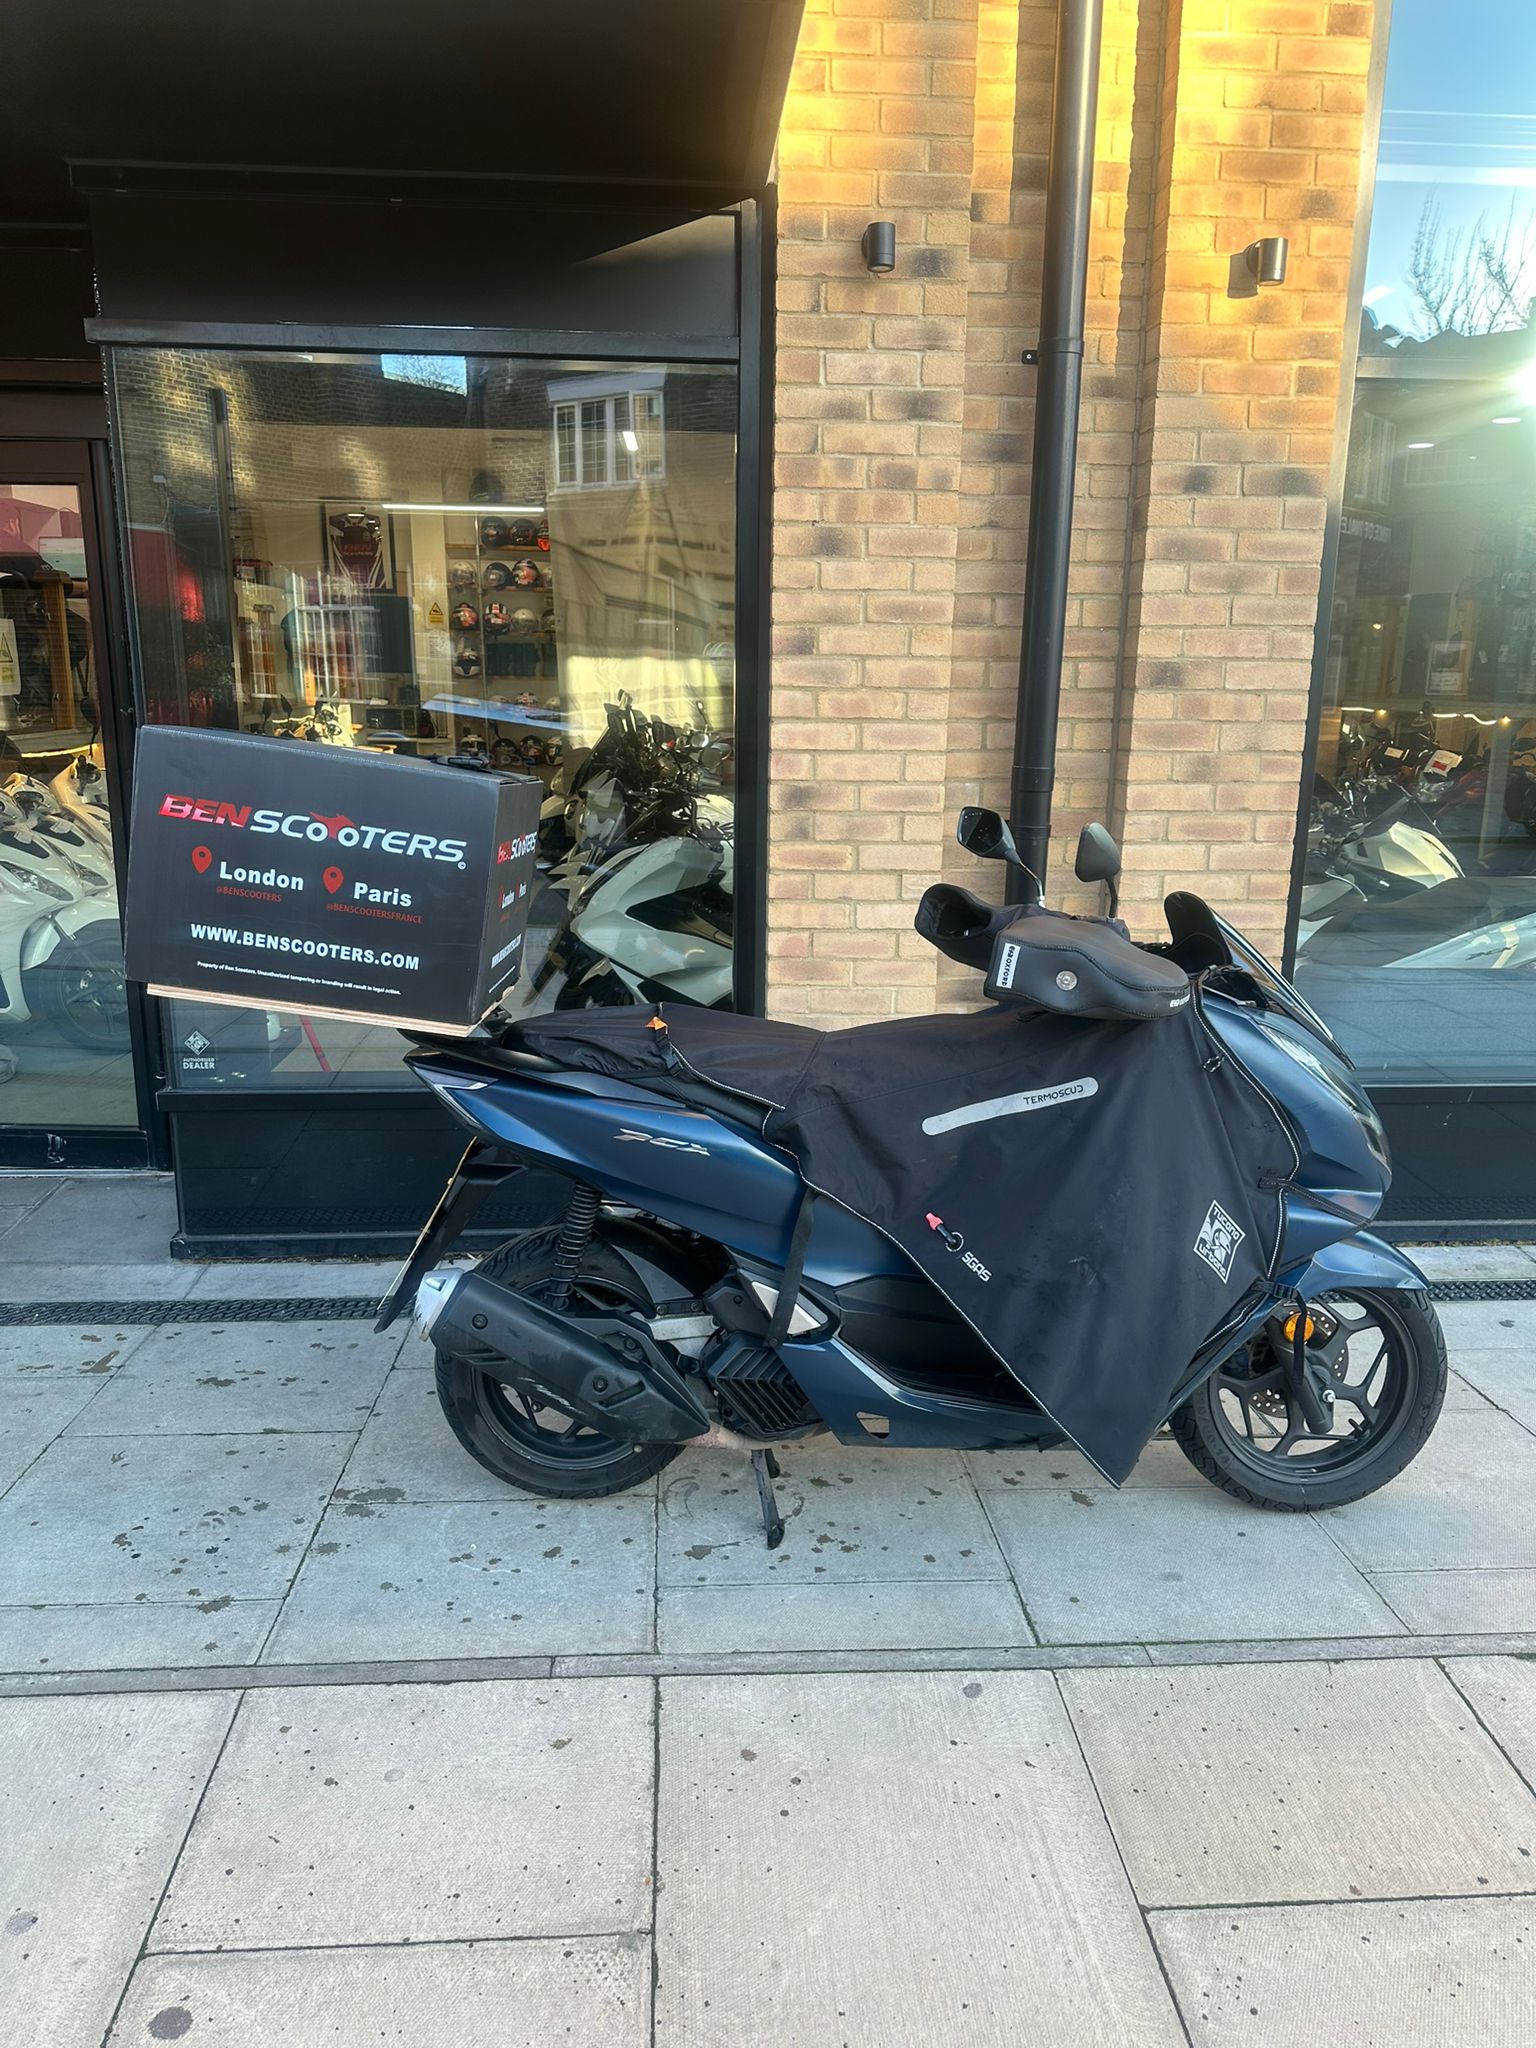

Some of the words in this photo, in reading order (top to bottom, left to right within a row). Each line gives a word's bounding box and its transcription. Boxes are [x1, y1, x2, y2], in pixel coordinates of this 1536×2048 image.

[219, 861, 304, 891] London
[216, 886, 282, 902] @BENSCOOTERS
[353, 881, 412, 907] Paris
[326, 903, 423, 924] @BENSCOOTERSFRANCE
[190, 923, 419, 970] WWW.BENSCOOTERS.COM
[197, 960, 218, 970] Property
[1001, 958, 1012, 987] OXFORD
[182, 1062, 216, 1070] DEALER
[1023, 1084, 1084, 1106] TERMOSCUD
[613, 1128, 711, 1156] PCX
[961, 1251, 993, 1283] SGAS
